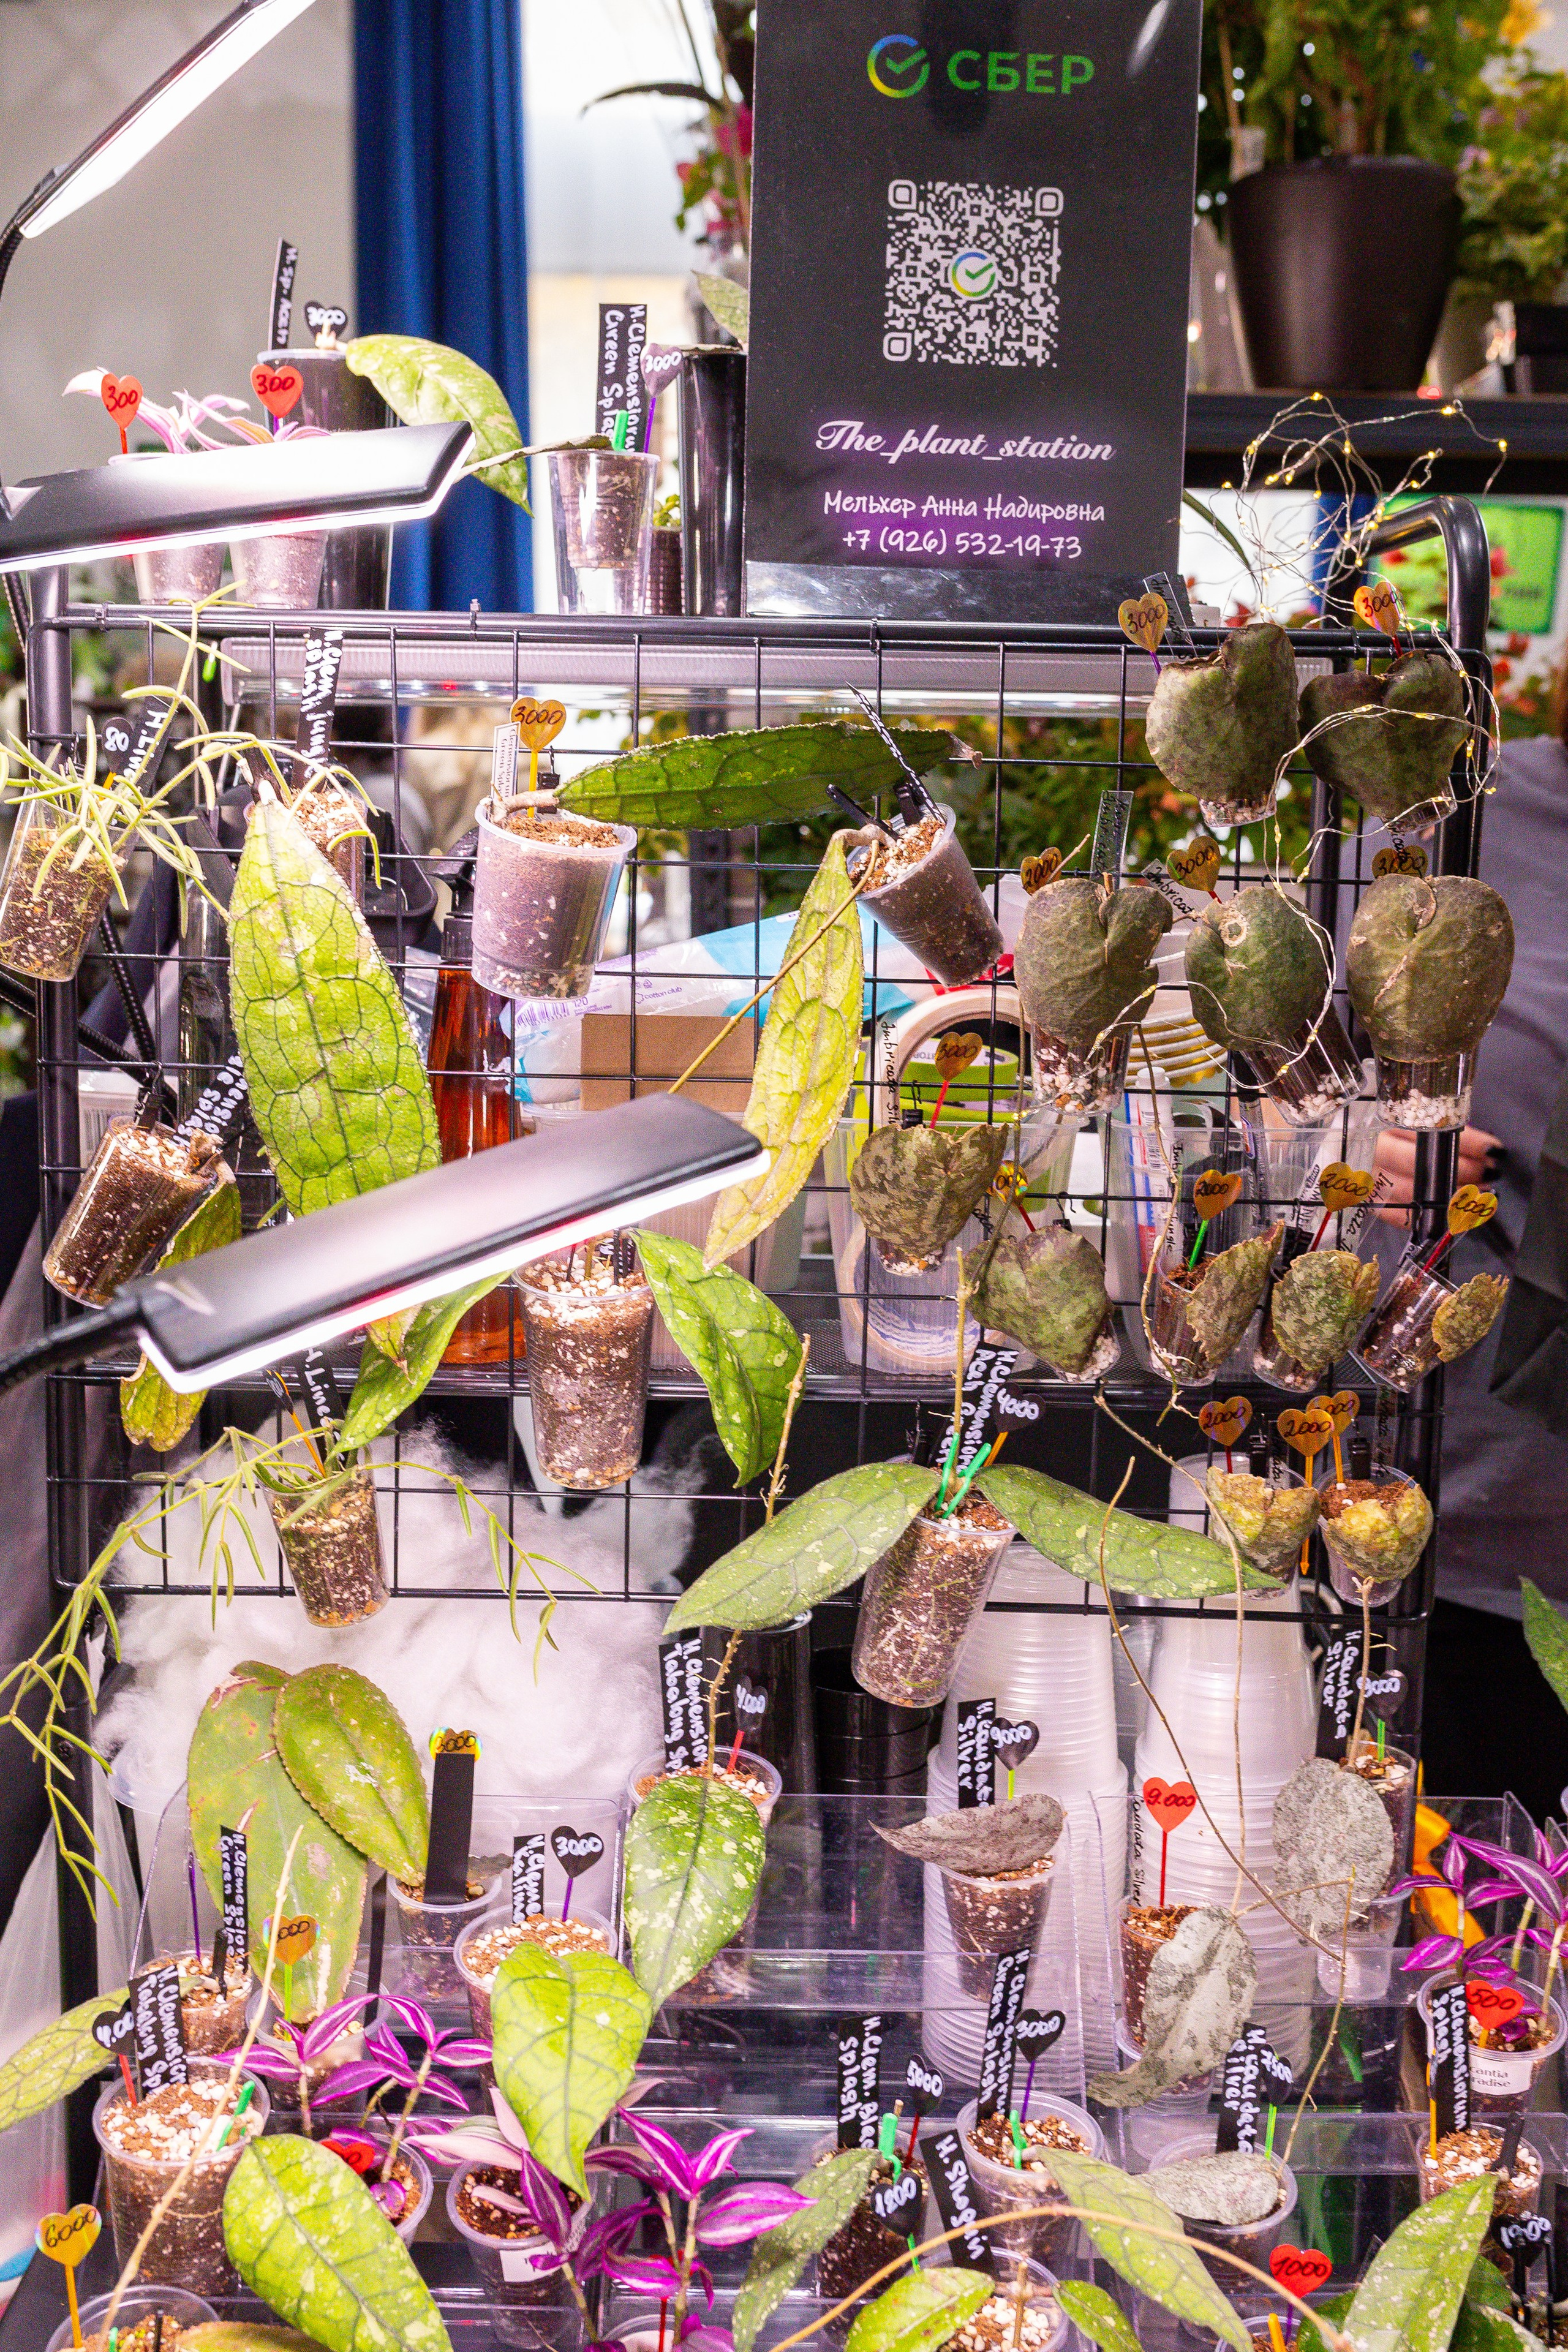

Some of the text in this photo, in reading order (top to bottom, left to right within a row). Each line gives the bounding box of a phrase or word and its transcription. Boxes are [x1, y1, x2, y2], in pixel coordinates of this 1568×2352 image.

[947, 50, 1095, 94] СБЕР
[604, 309, 625, 375] Green
[644, 350, 682, 374] 3000
[257, 375, 295, 395] 300
[625, 304, 646, 452] H.Clemensioru
[106, 385, 138, 413] 300
[815, 420, 1117, 464] The_plant_station
[824, 490, 1105, 524] Мельхер Анна Надировна
[842, 526, 1082, 559] +7 (926) 532-19-73
[1127, 603, 1164, 635] 3000
[514, 705, 564, 725] 3000
[1175, 845, 1216, 881] 3000
[644, 986, 683, 1000] cotton club
[1319, 1172, 1369, 1197] 2000
[1453, 1193, 1494, 1218] 2000
[997, 1388, 1039, 1420] 4000
[1317, 1399, 1355, 1415] 000
[1202, 1406, 1246, 1429] 2000
[1284, 1419, 1332, 1438] 2000
[682, 1638, 709, 1763] H.Clemensior
[989, 1724, 1033, 1749] 9000
[1147, 1787, 1195, 1807] 9.000
[555, 1836, 603, 1858] 3000
[221, 1835, 235, 1895] Green
[275, 1920, 311, 1943] 000
[1468, 1988, 1515, 2010] 500
[1015, 2015, 1061, 2040] 3000
[45, 2209, 97, 2248] 6000
[1273, 2256, 1327, 2277] 1000
